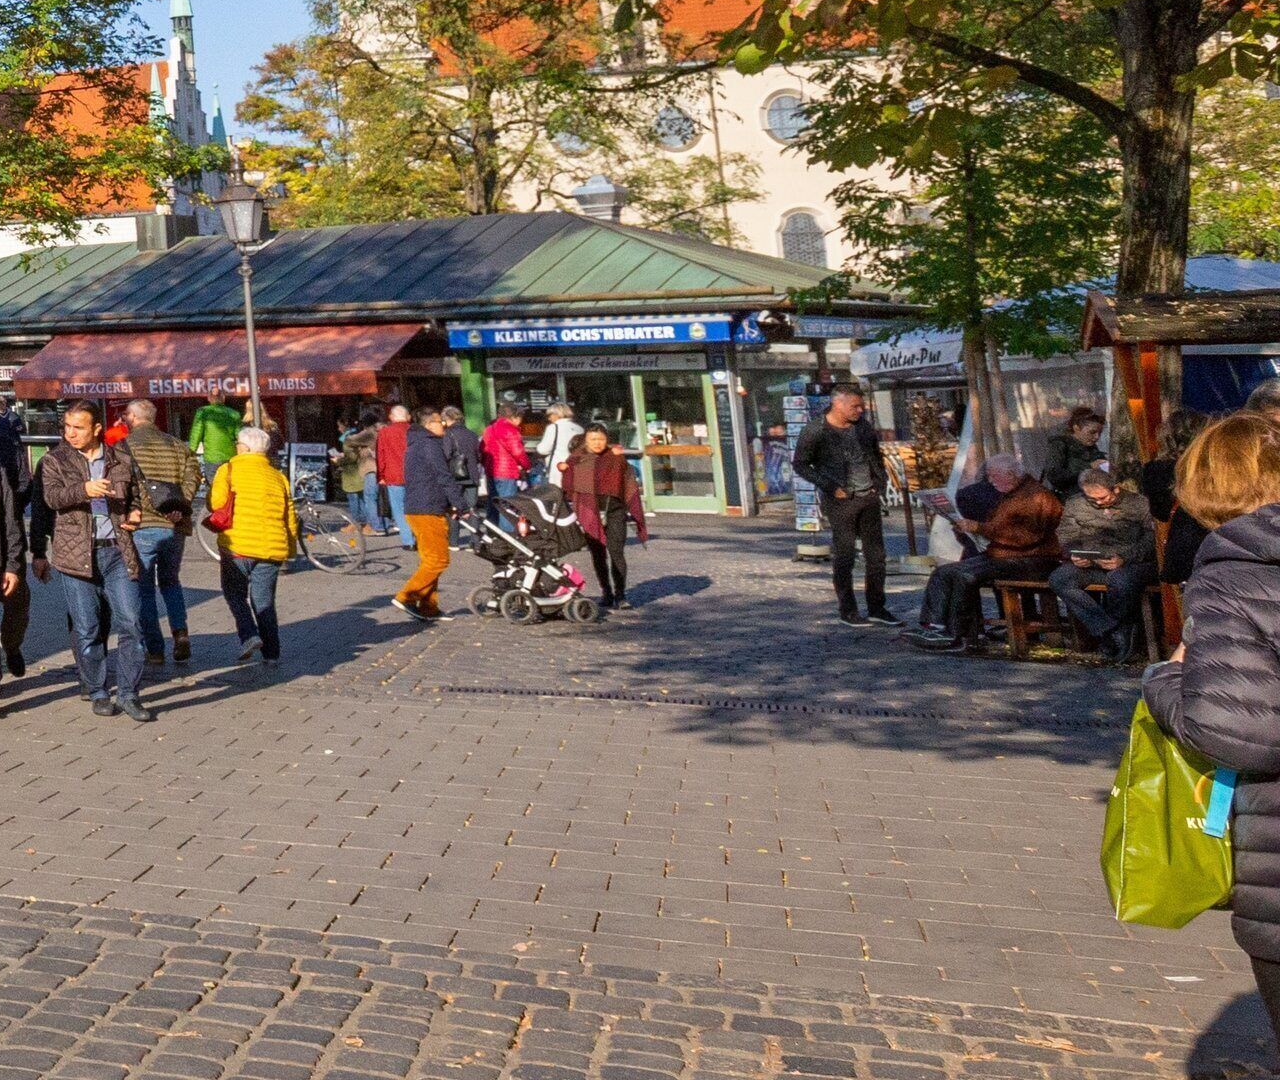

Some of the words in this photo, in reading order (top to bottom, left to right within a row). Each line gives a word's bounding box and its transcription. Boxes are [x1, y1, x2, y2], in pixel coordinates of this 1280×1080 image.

[494, 330, 558, 343] KLEINER
[561, 325, 675, 342] OCHS'NBRATER
[62, 381, 134, 394] METZGEREI
[268, 376, 316, 391] IMBISS
